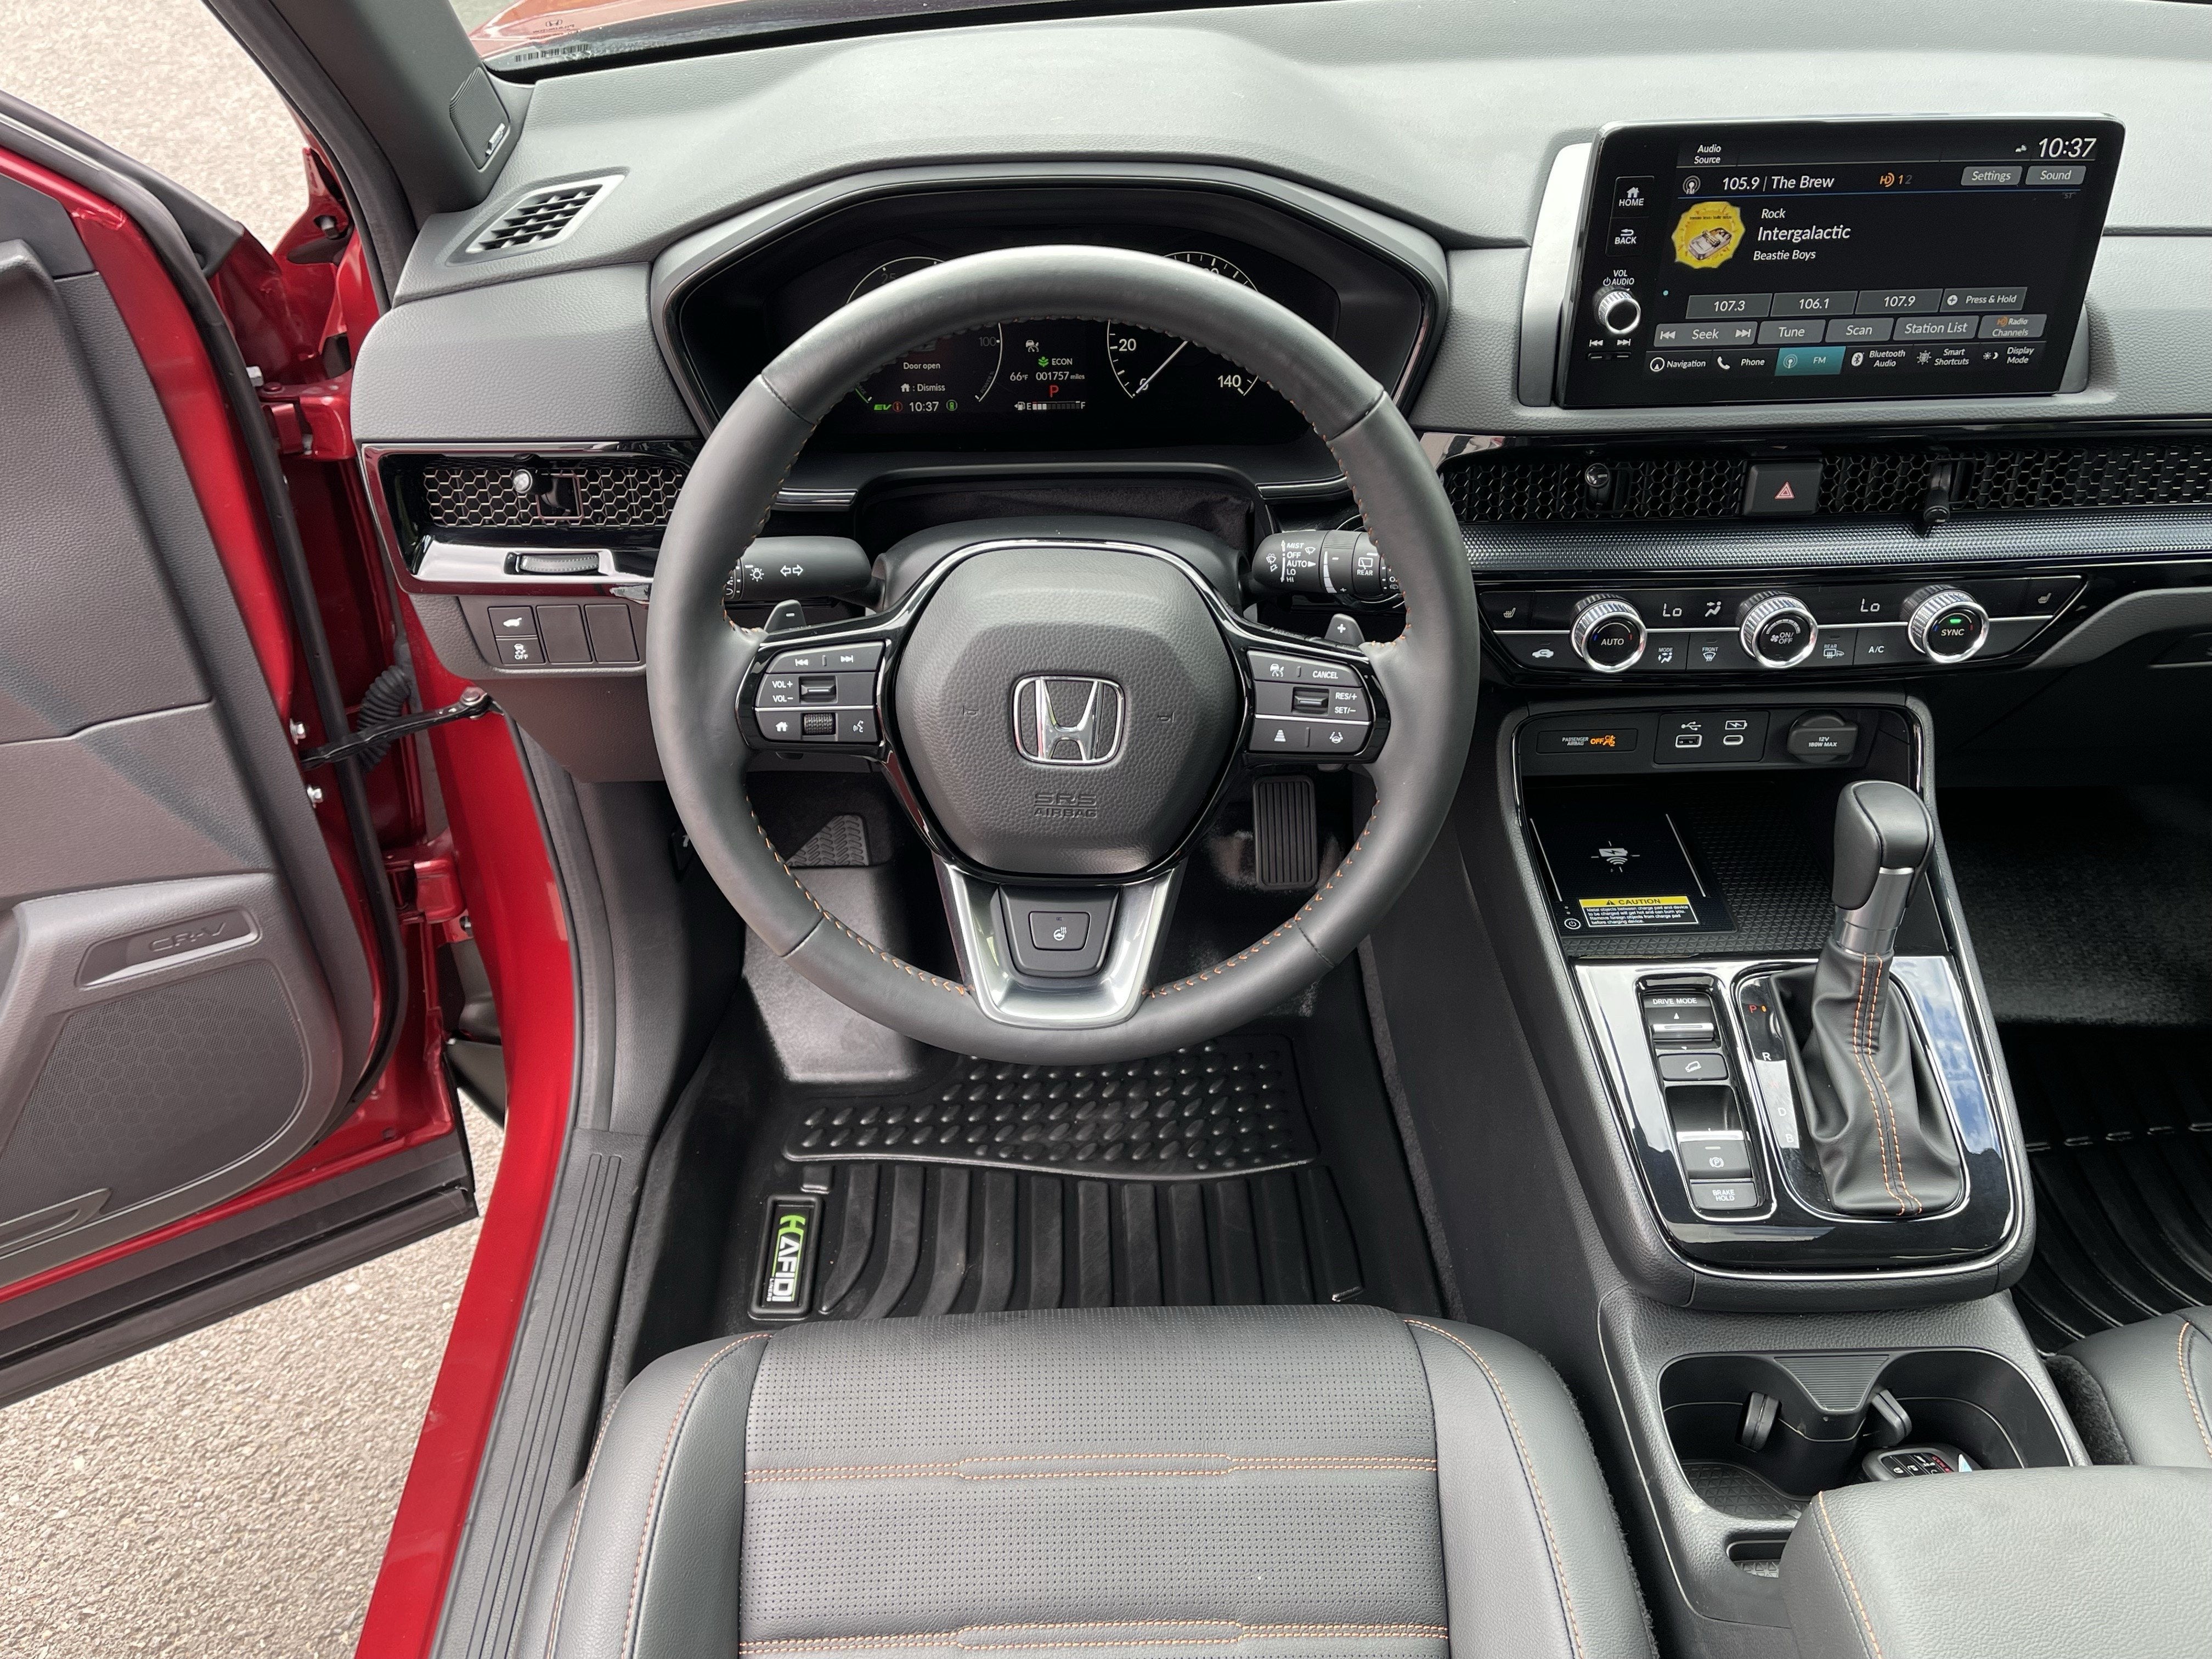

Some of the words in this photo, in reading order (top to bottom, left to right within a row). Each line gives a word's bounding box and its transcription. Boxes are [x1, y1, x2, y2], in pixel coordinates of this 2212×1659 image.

[1697, 144, 1721, 153] Audio
[2038, 137, 2096, 158] 10:37
[1694, 155, 1720, 165] Source
[1898, 174, 1903, 184] 1
[1905, 174, 1912, 184] 2
[1971, 170, 2012, 182] Settings
[2040, 170, 2071, 180] Sound
[1722, 177, 1759, 190] 105.9
[1771, 176, 1796, 189] The
[1799, 175, 1835, 188] Brew
[1619, 198, 1644, 207] HOME
[1762, 209, 1785, 219] Rock
[1758, 225, 1850, 243] Intergalactic
[1615, 236, 1636, 245] BACK
[1753, 251, 1790, 260] Beastie
[1792, 250, 1816, 261] Boys
[1611, 277, 1634, 286] AUDIO
[1799, 298, 1830, 309] 106.1
[1883, 296, 1915, 307] 107.9
[1965, 295, 1987, 304] Press
[1989, 295, 1995, 303] &
[1997, 294, 2016, 303] Hold
[1714, 300, 1745, 312] 107.3
[1779, 326, 1805, 337] Tune
[1846, 324, 1872, 335] Scan
[1904, 323, 1944, 334] Station
[1948, 322, 1967, 333] List
[1992, 329, 2028, 337] Channels
[1692, 329, 1719, 340] Seek
[979, 336, 996, 347] 100
[1119, 339, 1136, 352] 20
[1869, 349, 1905, 358] Bluetooth
[1943, 348, 1965, 357] Smart
[2007, 347, 2035, 356] Display
[1667, 359, 1706, 369] Navigation
[1741, 357, 1765, 366] Phone
[1874, 359, 1896, 367] Audio
[1934, 357, 1969, 366] Shortcuts
[922, 363, 940, 372] open
[1036, 371, 1069, 381] 001757
[1217, 375, 1241, 387] 140
[917, 383, 945, 392] Dismiss
[1049, 385, 1059, 398] P
[909, 402, 939, 411] 10:37
[1026, 402, 1031, 410] E
[1601, 637, 1624, 646] AUTO
[1869, 645, 1884, 653] A/C
[1312, 670, 1338, 679] CANCEL
[1335, 692, 1357, 700] RES/+
[1035, 793, 1097, 806] SRS
[1034, 808, 1098, 819] AIRBAG
[1748, 1005, 1757, 1013] P
[1762, 1052, 1771, 1061] R
[1778, 1107, 1787, 1116] D
[1785, 1133, 1795, 1143] B
